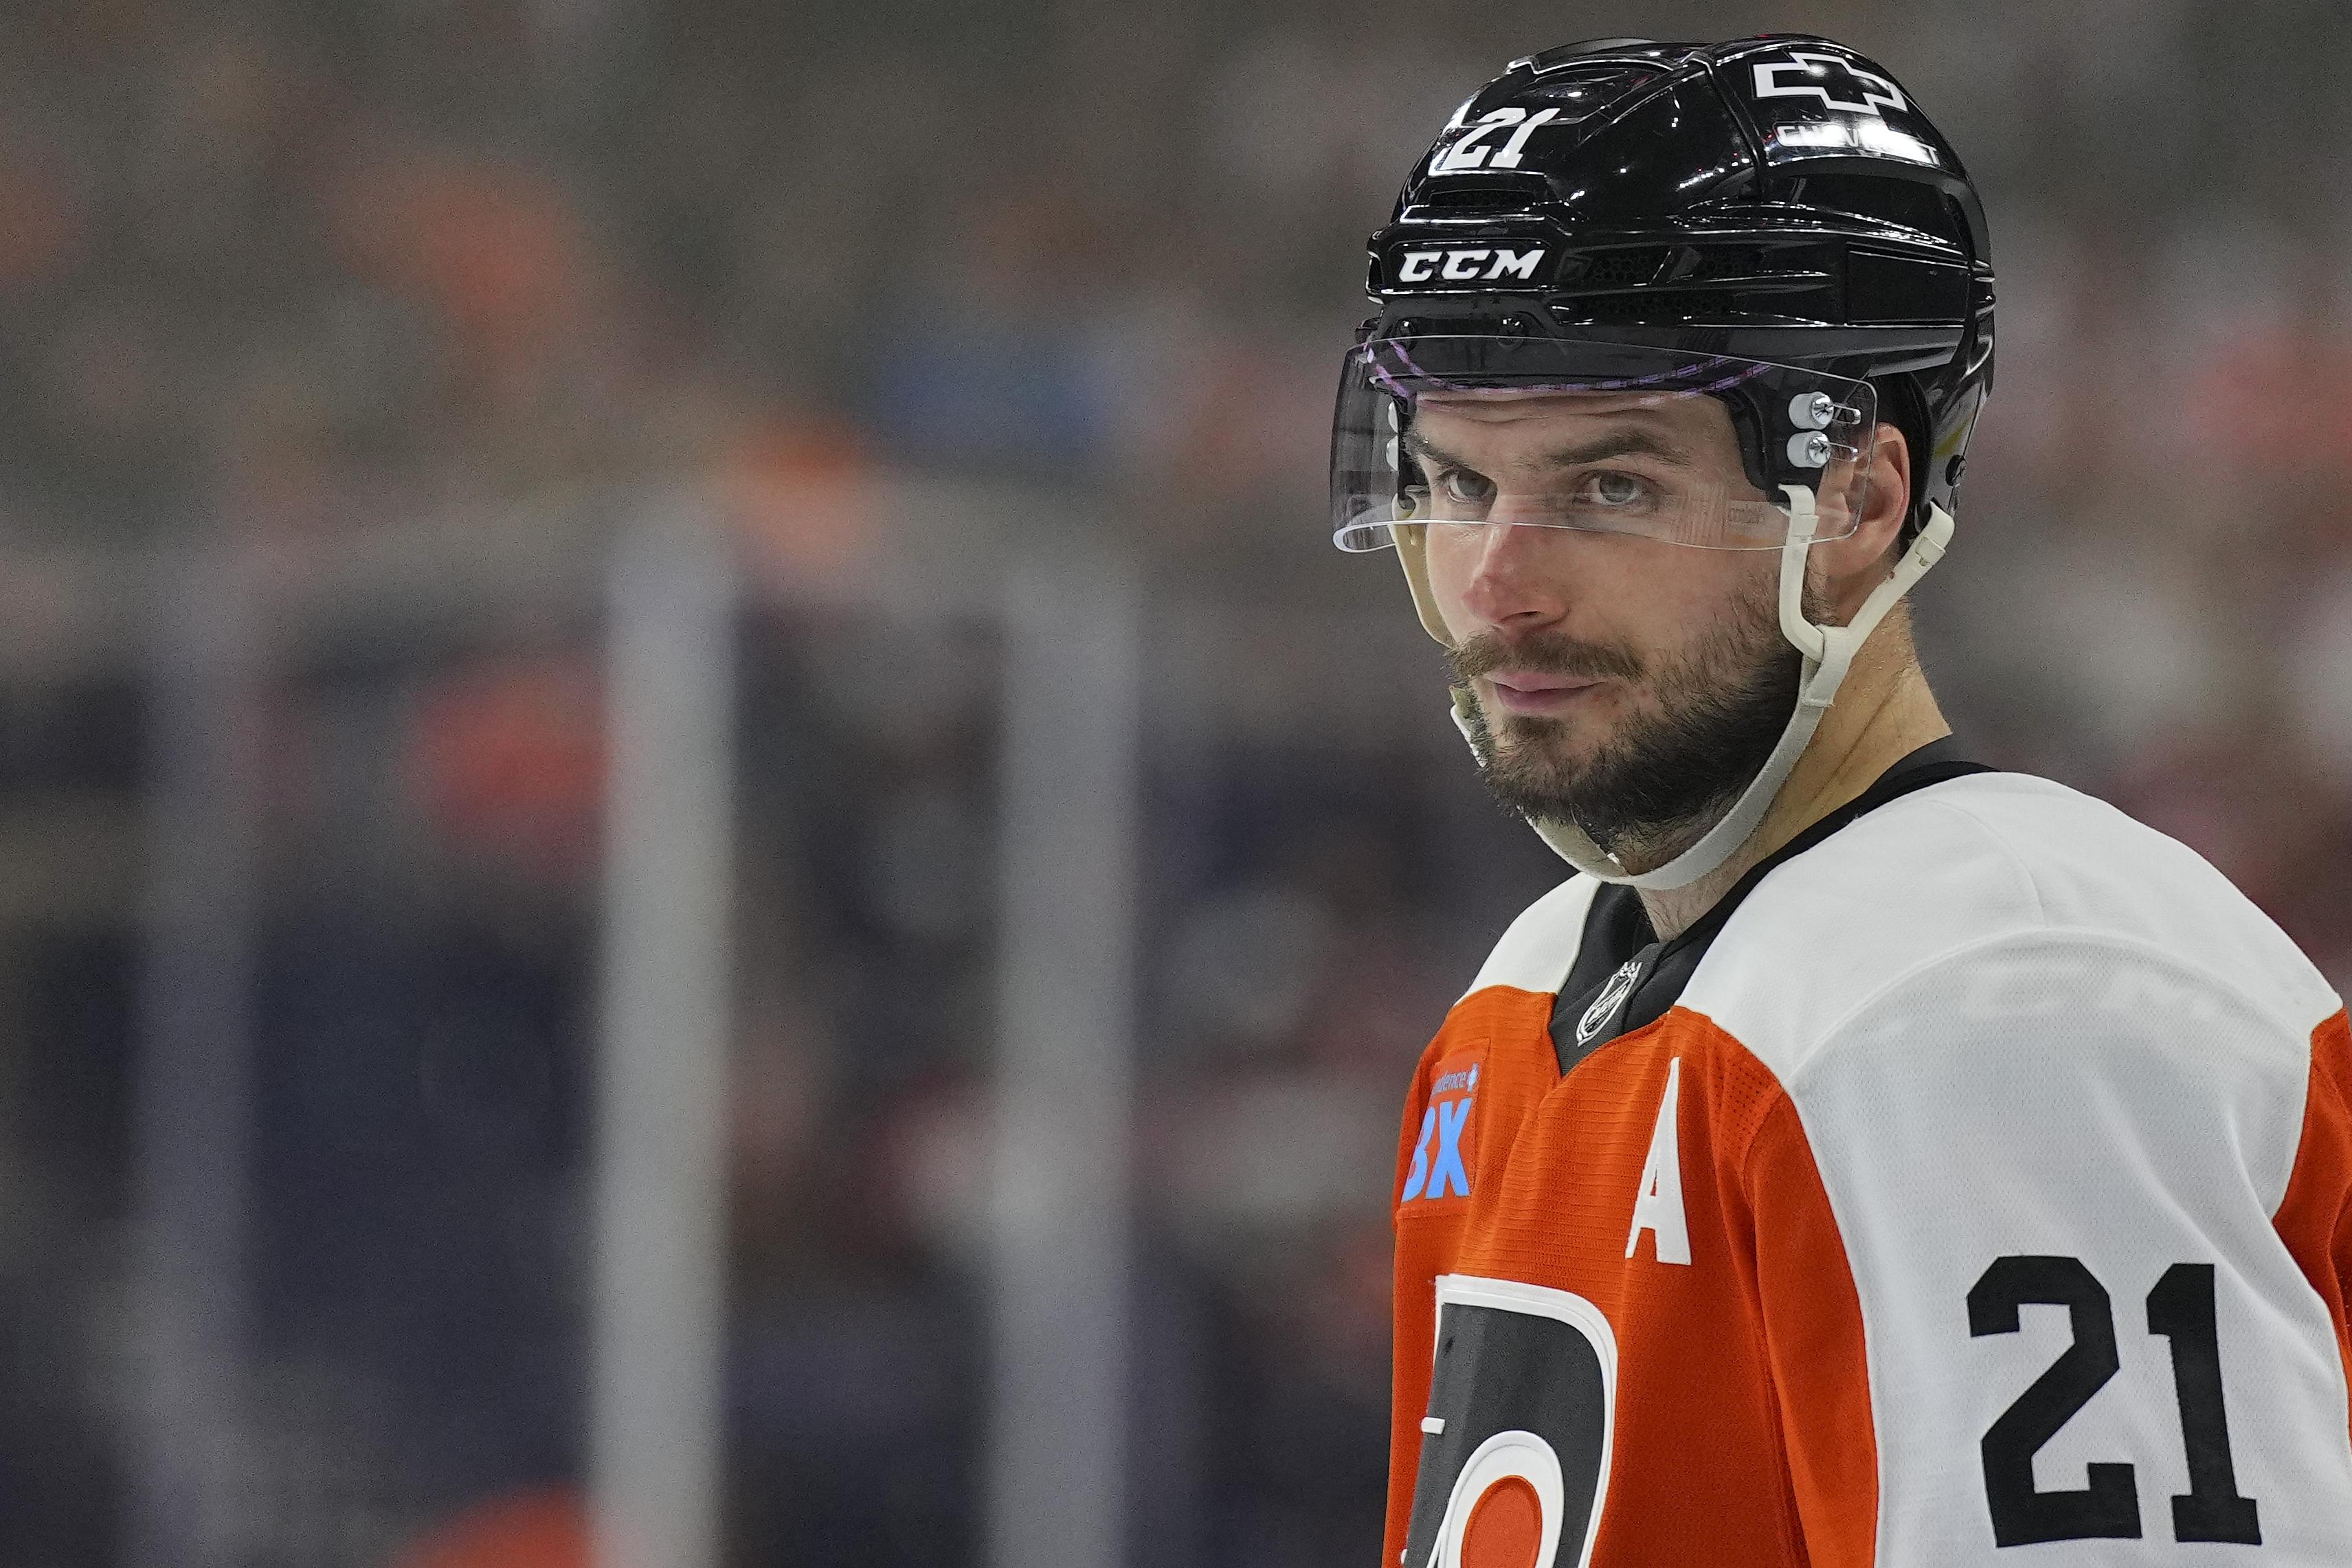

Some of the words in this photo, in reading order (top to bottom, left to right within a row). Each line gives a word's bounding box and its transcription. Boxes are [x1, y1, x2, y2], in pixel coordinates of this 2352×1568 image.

[1439, 107, 1561, 171] 21
[1398, 249, 1545, 282] CCM
[1624, 1056, 1692, 1266] A
[1966, 1255, 2263, 1548] 21
